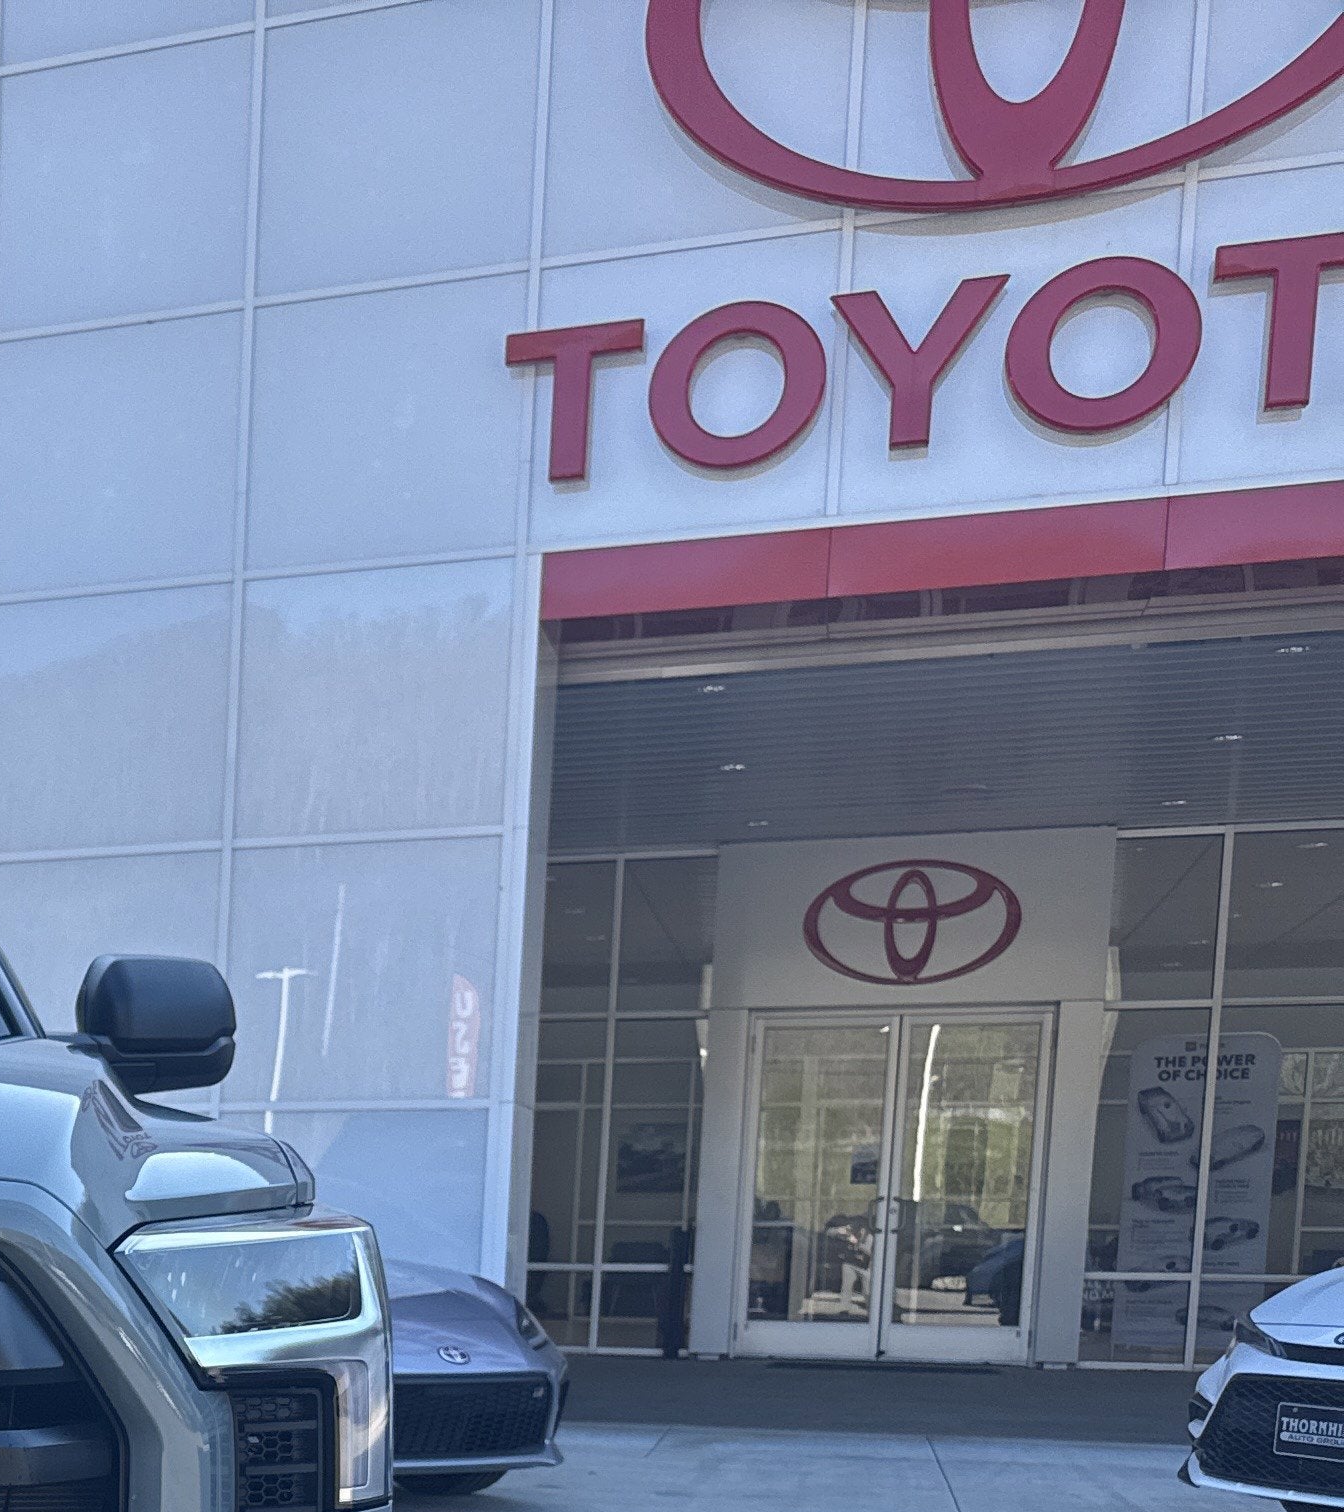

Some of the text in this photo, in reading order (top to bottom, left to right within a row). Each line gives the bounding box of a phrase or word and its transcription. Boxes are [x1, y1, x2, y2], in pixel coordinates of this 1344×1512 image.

[1154, 1056, 1186, 1069] THE
[1157, 1069, 1181, 1082] OF
[1280, 1416, 1344, 1438] THORNHI
[1287, 1433, 1315, 1443] AUTO
